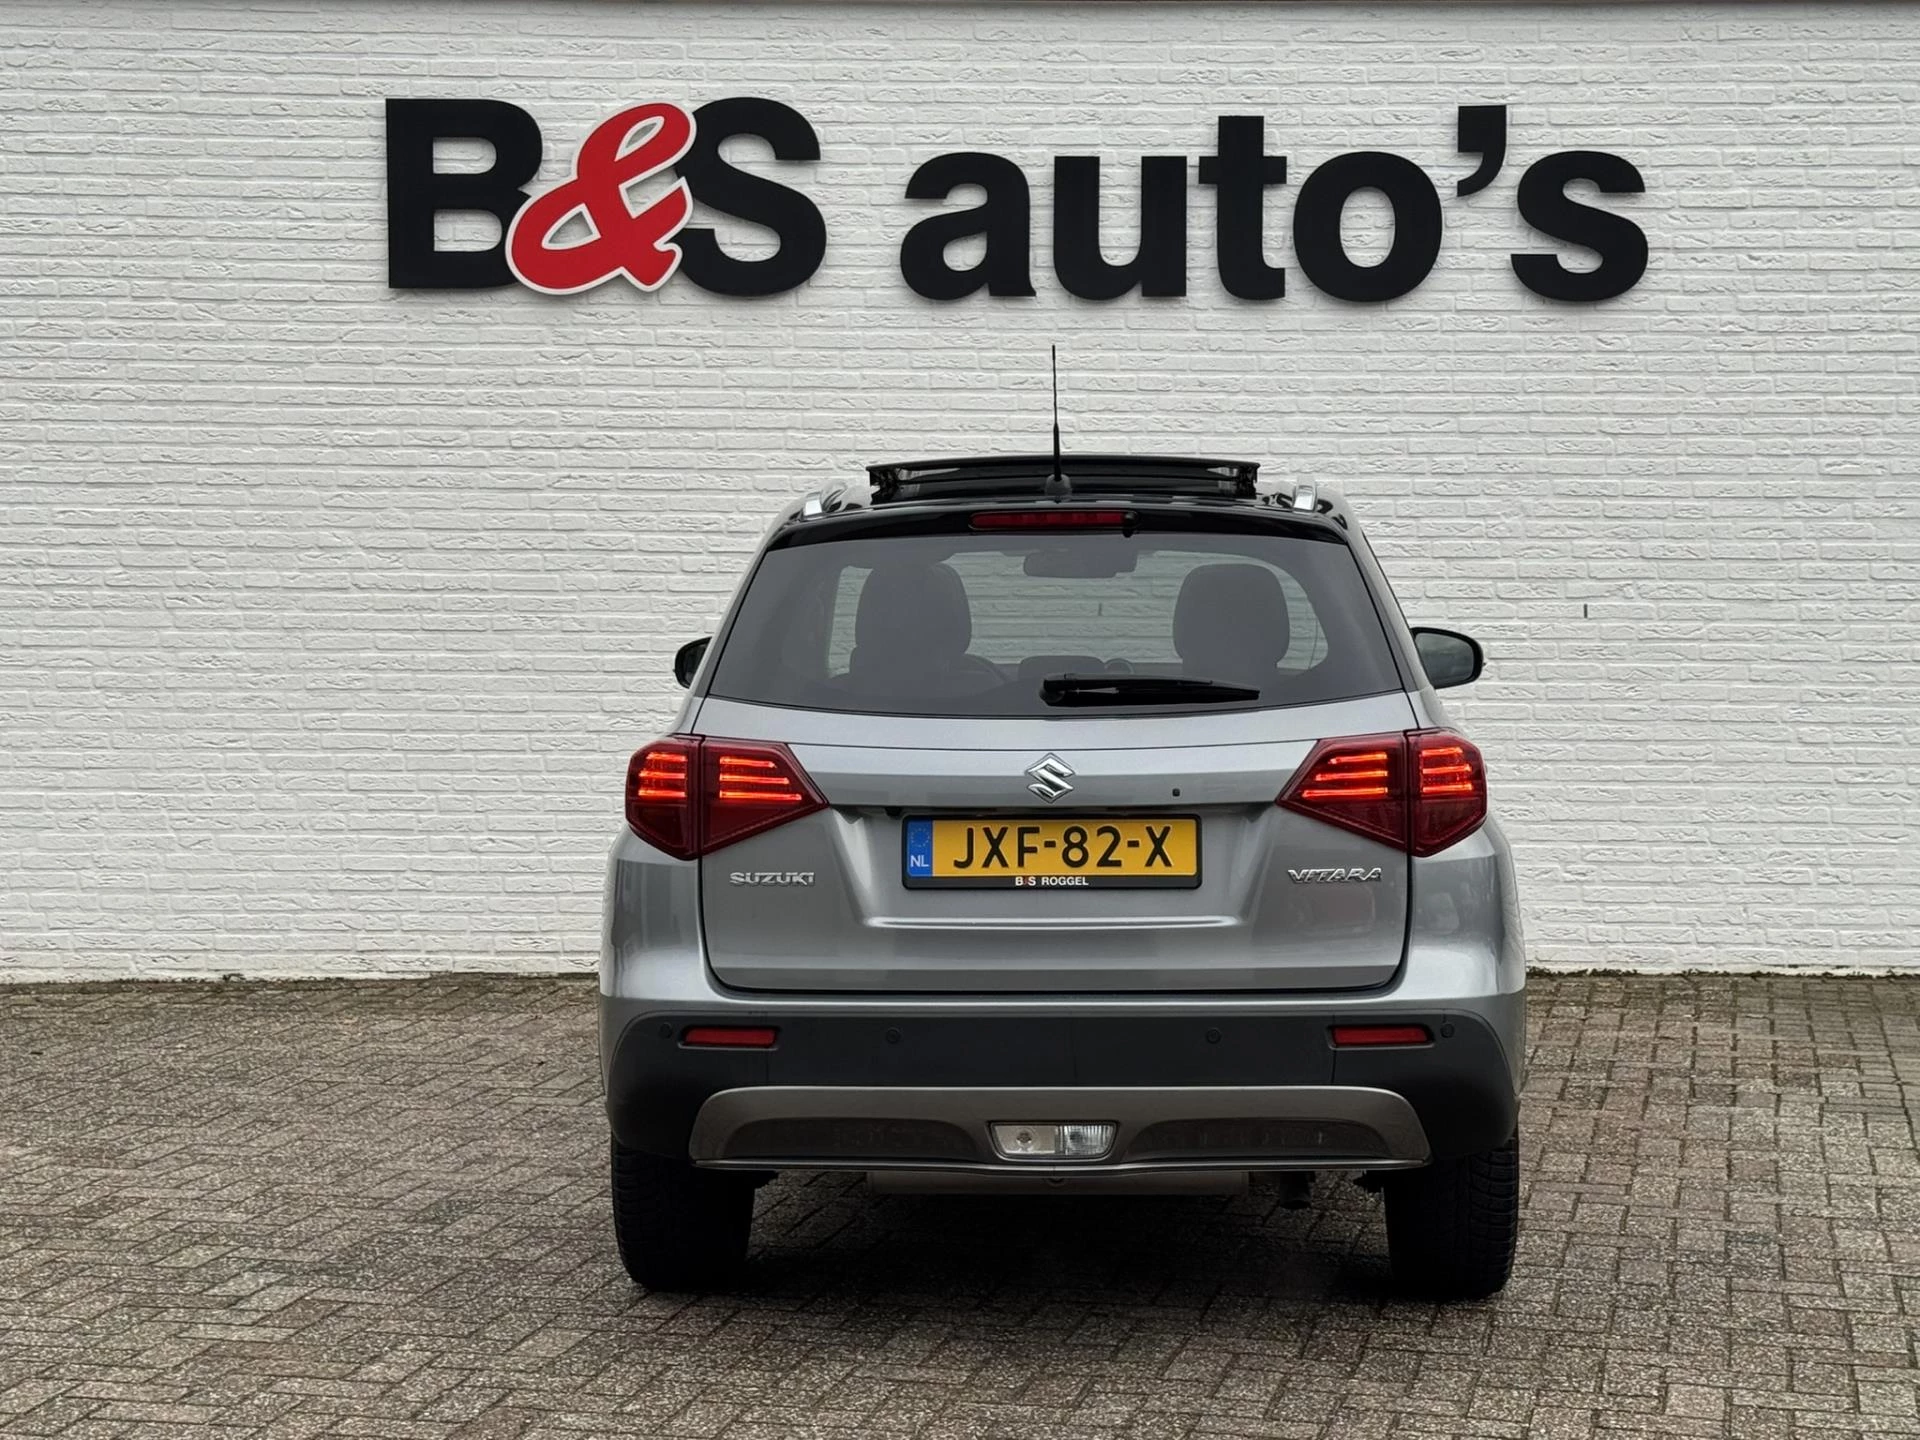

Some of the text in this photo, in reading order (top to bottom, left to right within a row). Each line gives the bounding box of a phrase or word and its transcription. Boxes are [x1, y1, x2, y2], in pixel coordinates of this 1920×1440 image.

[386, 97, 1649, 301] B&S auto's
[953, 826, 1173, 869] JXF-82-X
[910, 855, 929, 867] NL
[730, 872, 814, 885] SUZUKI
[1041, 876, 1089, 886] ROGGEL
[1288, 867, 1382, 883] VITARA
